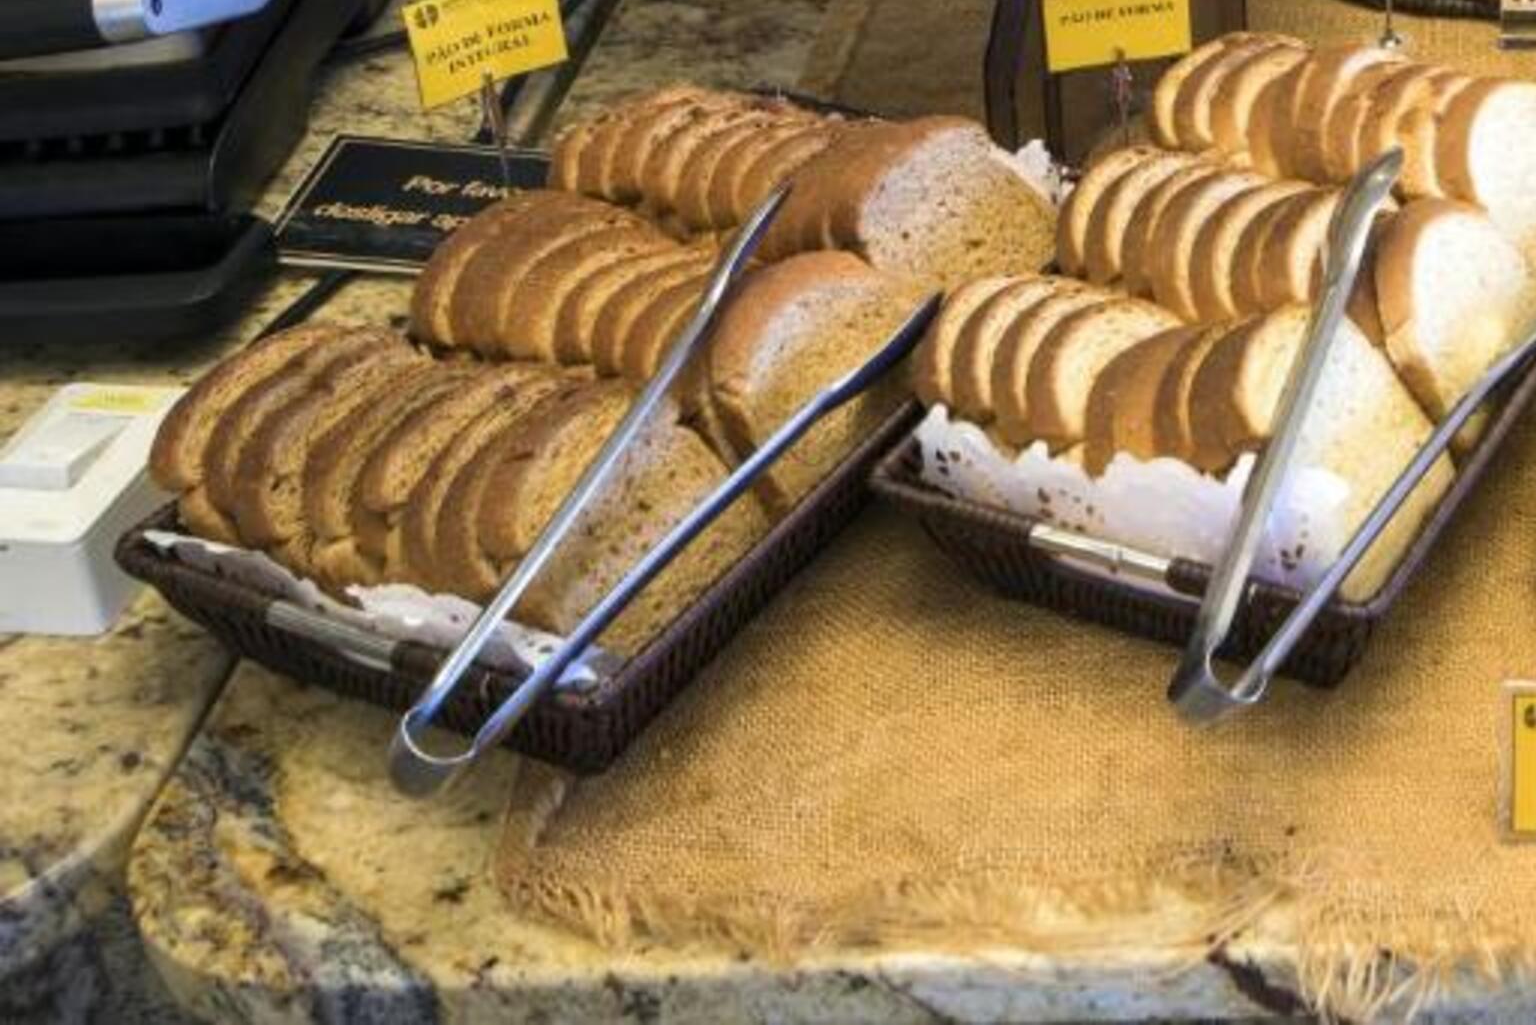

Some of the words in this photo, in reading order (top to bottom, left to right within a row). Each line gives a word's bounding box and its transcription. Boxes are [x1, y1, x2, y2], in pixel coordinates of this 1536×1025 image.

[427, 43, 460, 65] PÃO
[462, 31, 483, 49] DE
[485, 10, 551, 39] FORMA
